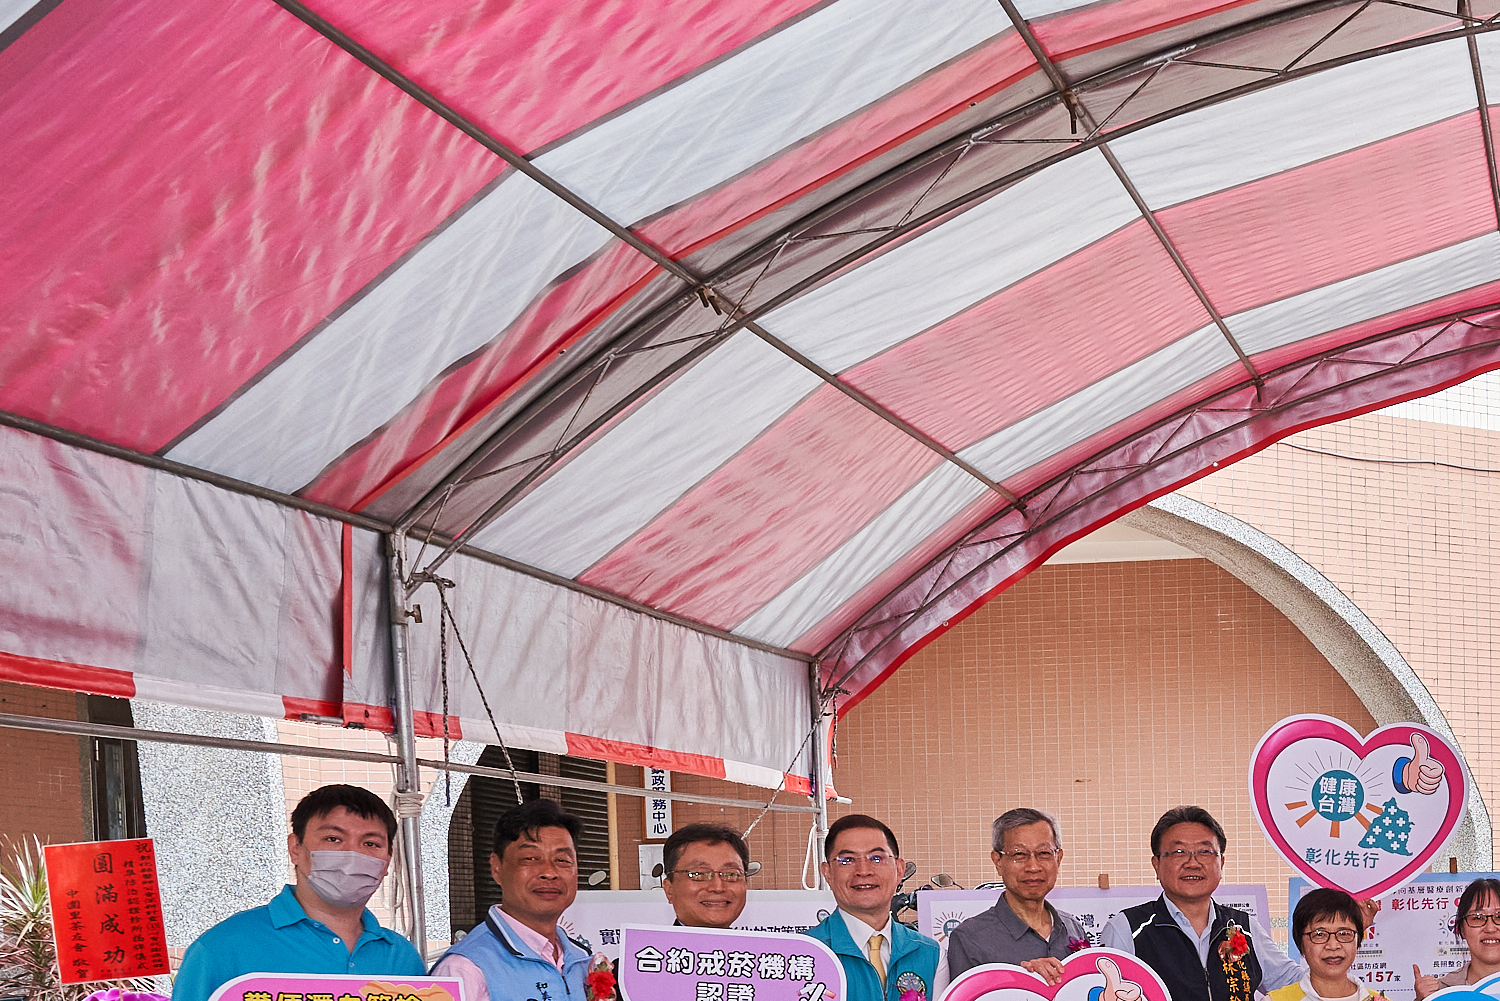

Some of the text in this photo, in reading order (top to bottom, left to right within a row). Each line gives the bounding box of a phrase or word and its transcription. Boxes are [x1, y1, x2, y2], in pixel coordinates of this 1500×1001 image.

[1319, 776, 1357, 797] 健康
[1317, 795, 1356, 815] 台灣
[1305, 847, 1379, 869] 彰化先行
[94, 852, 125, 964] 圓滿成功
[1391, 897, 1449, 911] 彰化先行
[635, 945, 816, 981] 合約戒菸機構
